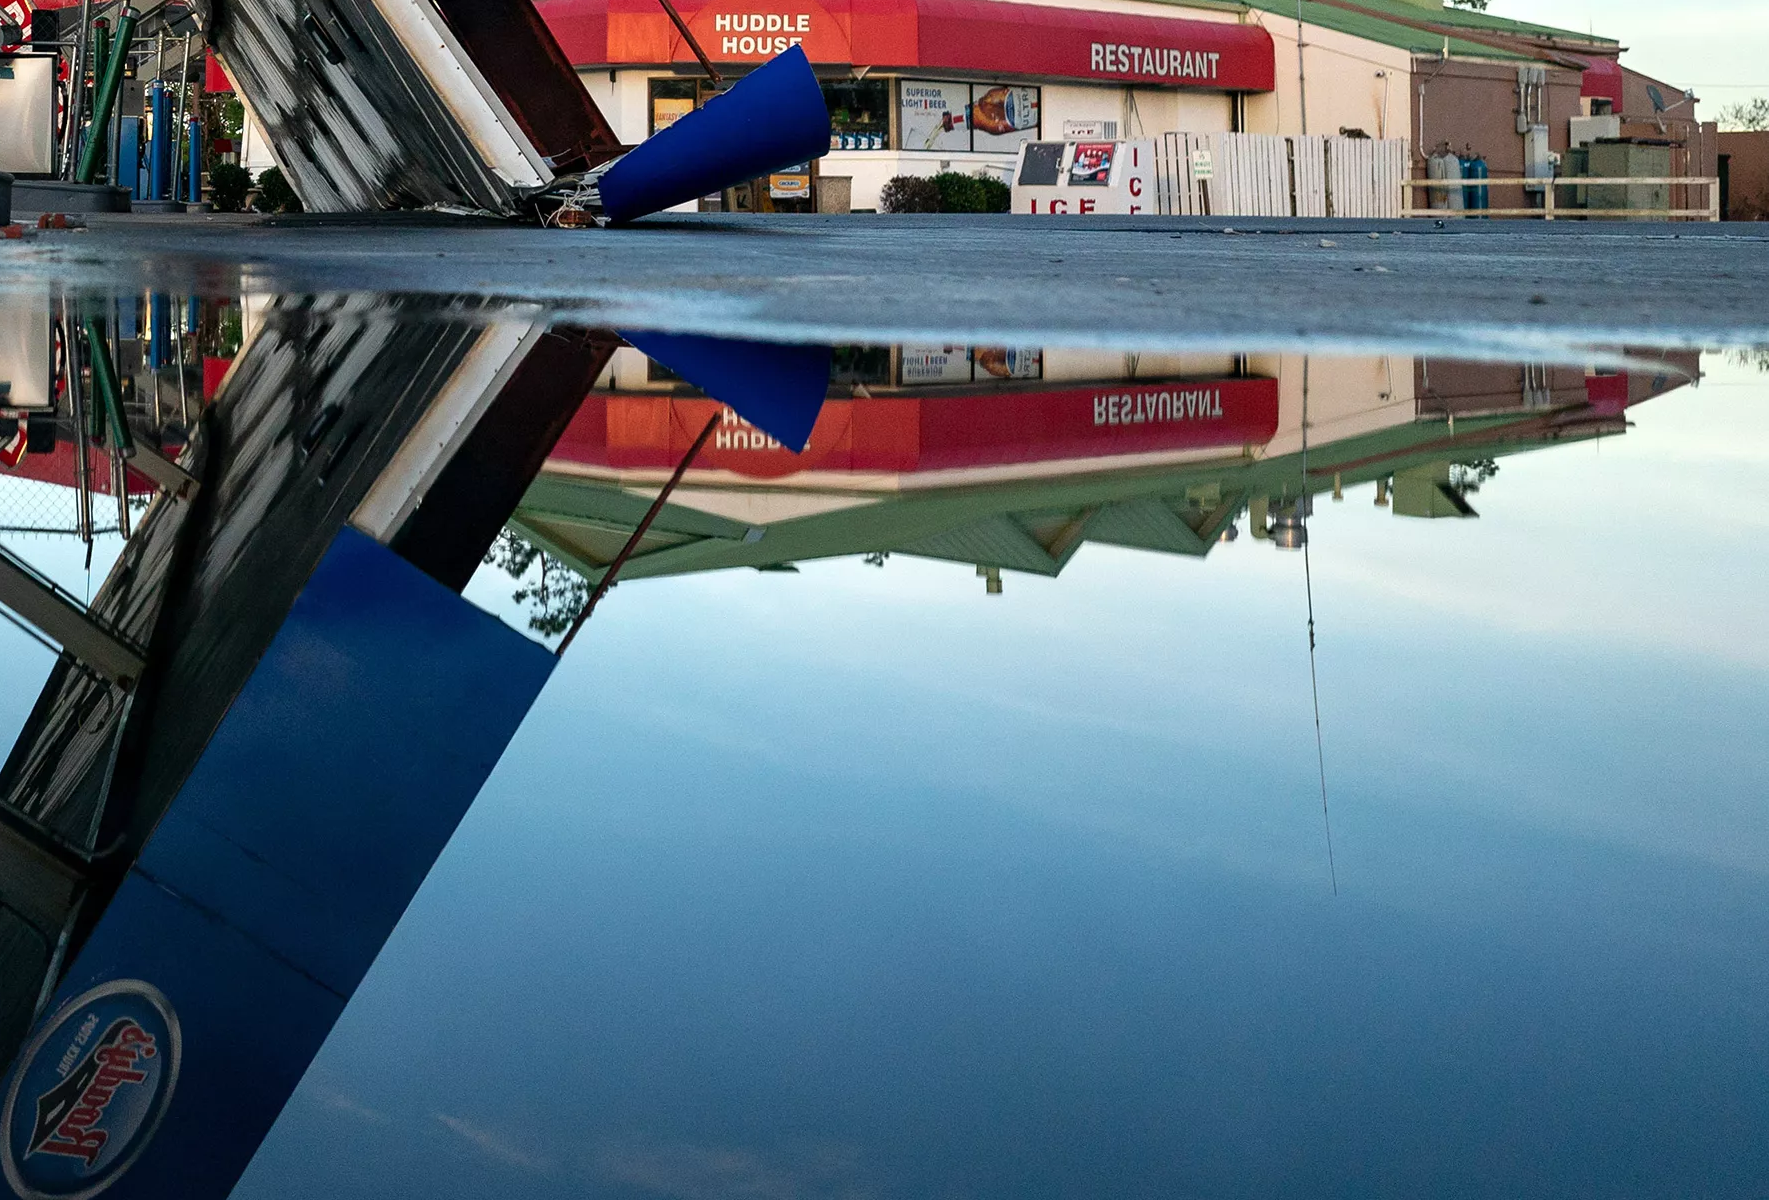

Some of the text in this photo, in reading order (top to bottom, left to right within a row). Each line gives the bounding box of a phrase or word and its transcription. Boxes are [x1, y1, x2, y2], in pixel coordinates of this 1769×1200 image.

[715, 13, 811, 32] HUDDLE
[1091, 42, 1220, 79] RESTAURANT
[906, 87, 942, 98] SUPERIOR
[901, 99, 947, 109] LIGHT BEER
